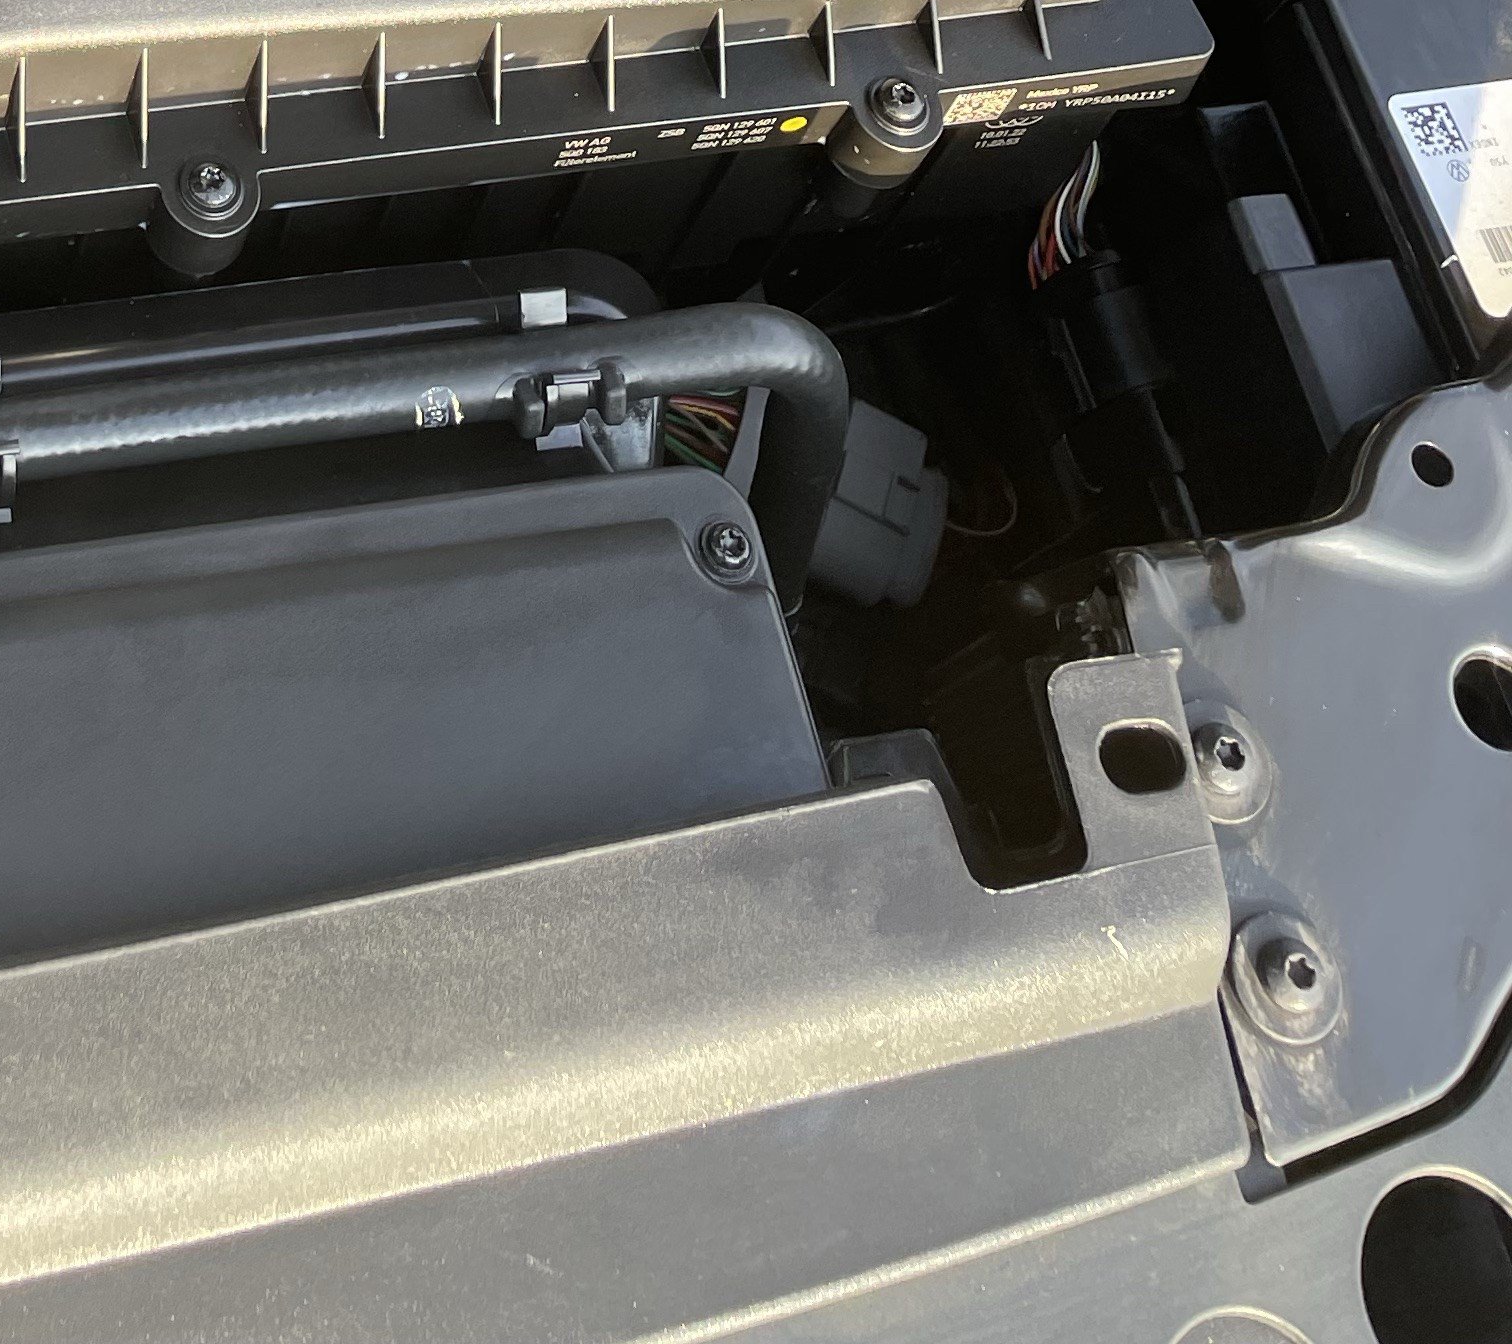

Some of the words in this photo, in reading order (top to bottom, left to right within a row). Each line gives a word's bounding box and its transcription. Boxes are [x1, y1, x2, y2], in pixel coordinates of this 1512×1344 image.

[1026, 88, 1070, 99] Mexico
[1071, 83, 1099, 94] YRP
[732, 120, 755, 130] 129
[565, 137, 588, 149] VW
[586, 136, 611, 146] AG
